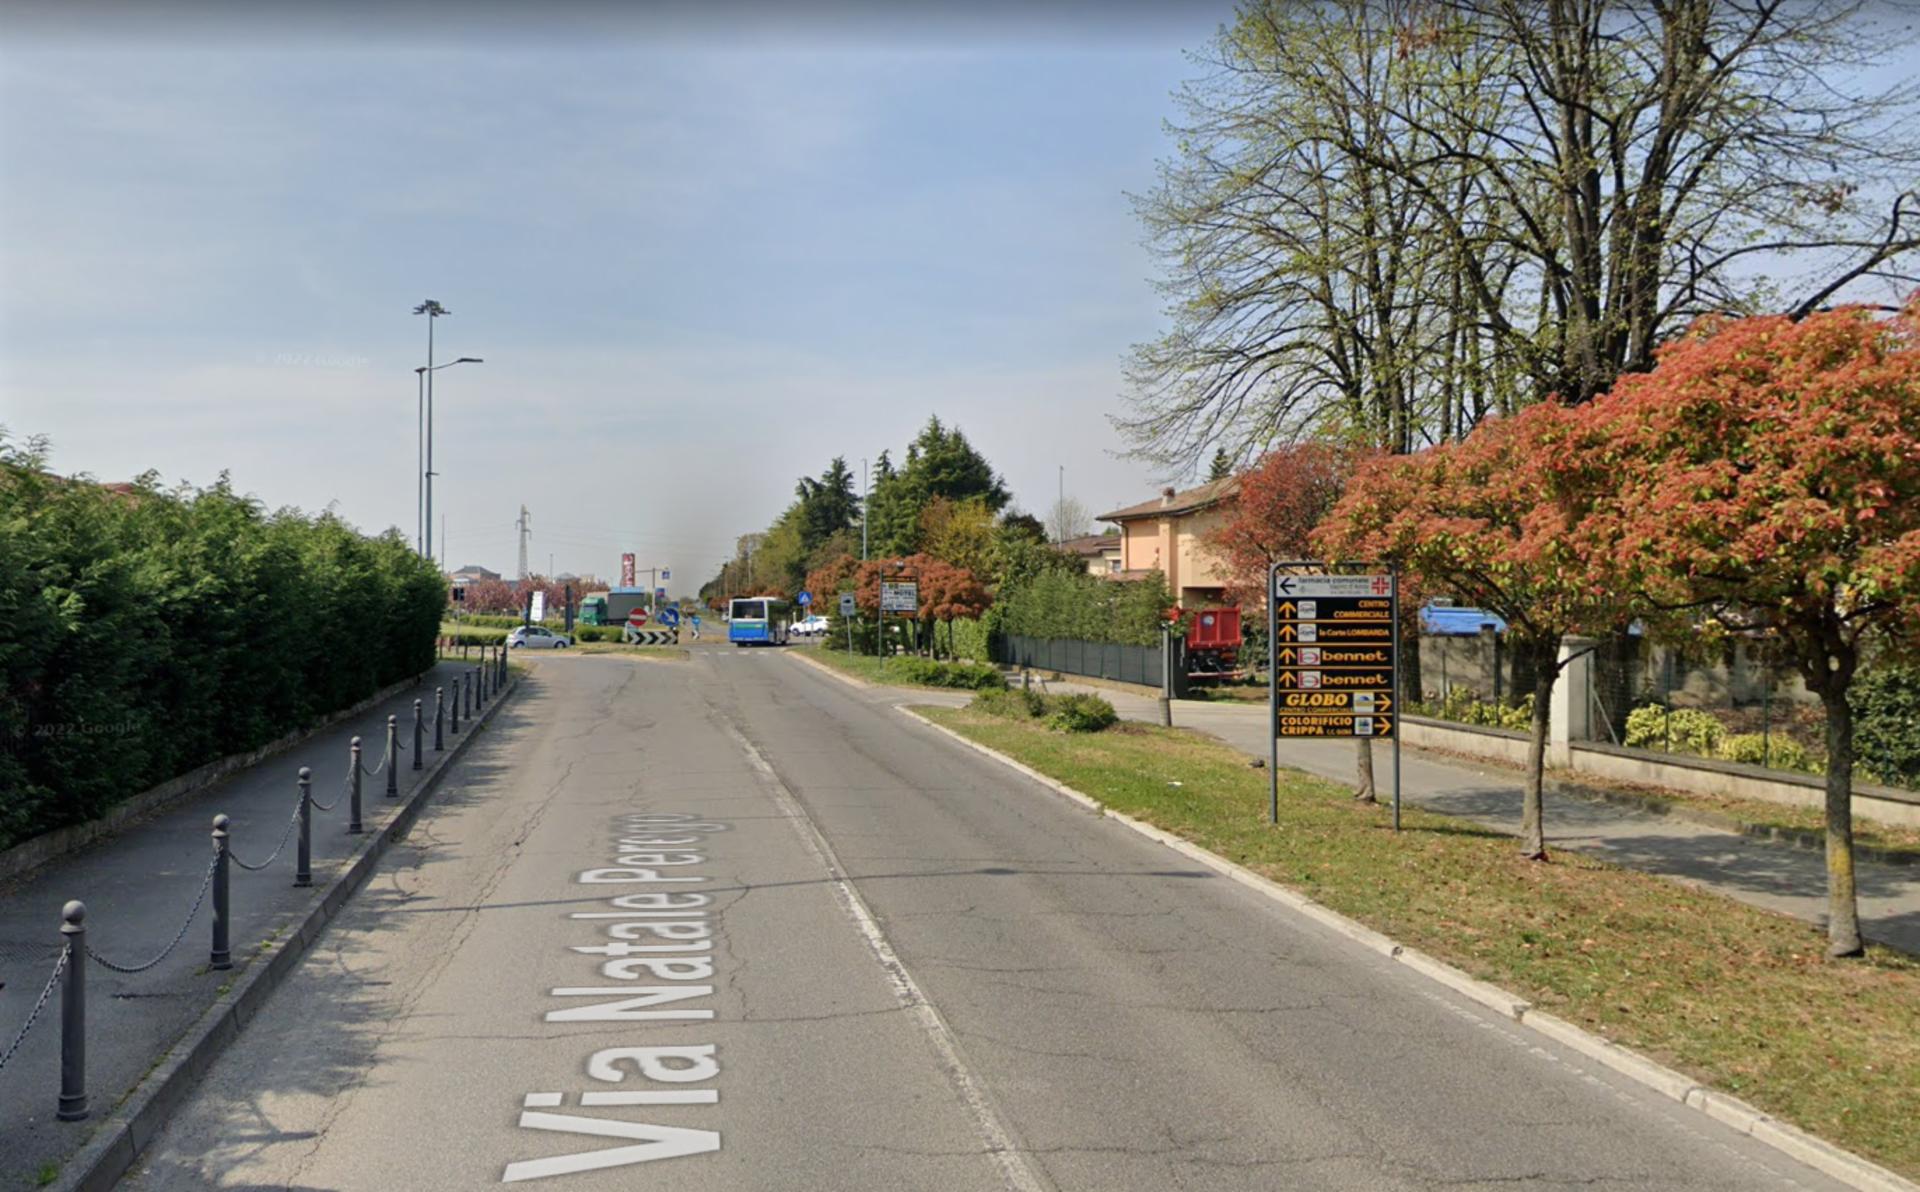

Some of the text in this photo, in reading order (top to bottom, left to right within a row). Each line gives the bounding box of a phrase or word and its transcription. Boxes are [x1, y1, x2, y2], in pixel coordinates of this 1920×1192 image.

[1358, 600, 1390, 608] CENTRO
[1333, 610, 1390, 618] COMMERCIALE
[1347, 629, 1390, 637] LOMBARDA
[1322, 650, 1388, 662] bennet
[1322, 673, 1388, 685] bennet
[1286, 693, 1348, 707] GLOBO
[1281, 716, 1353, 726] COLORIFICIO
[1281, 726, 1324, 735] CRIPPA
